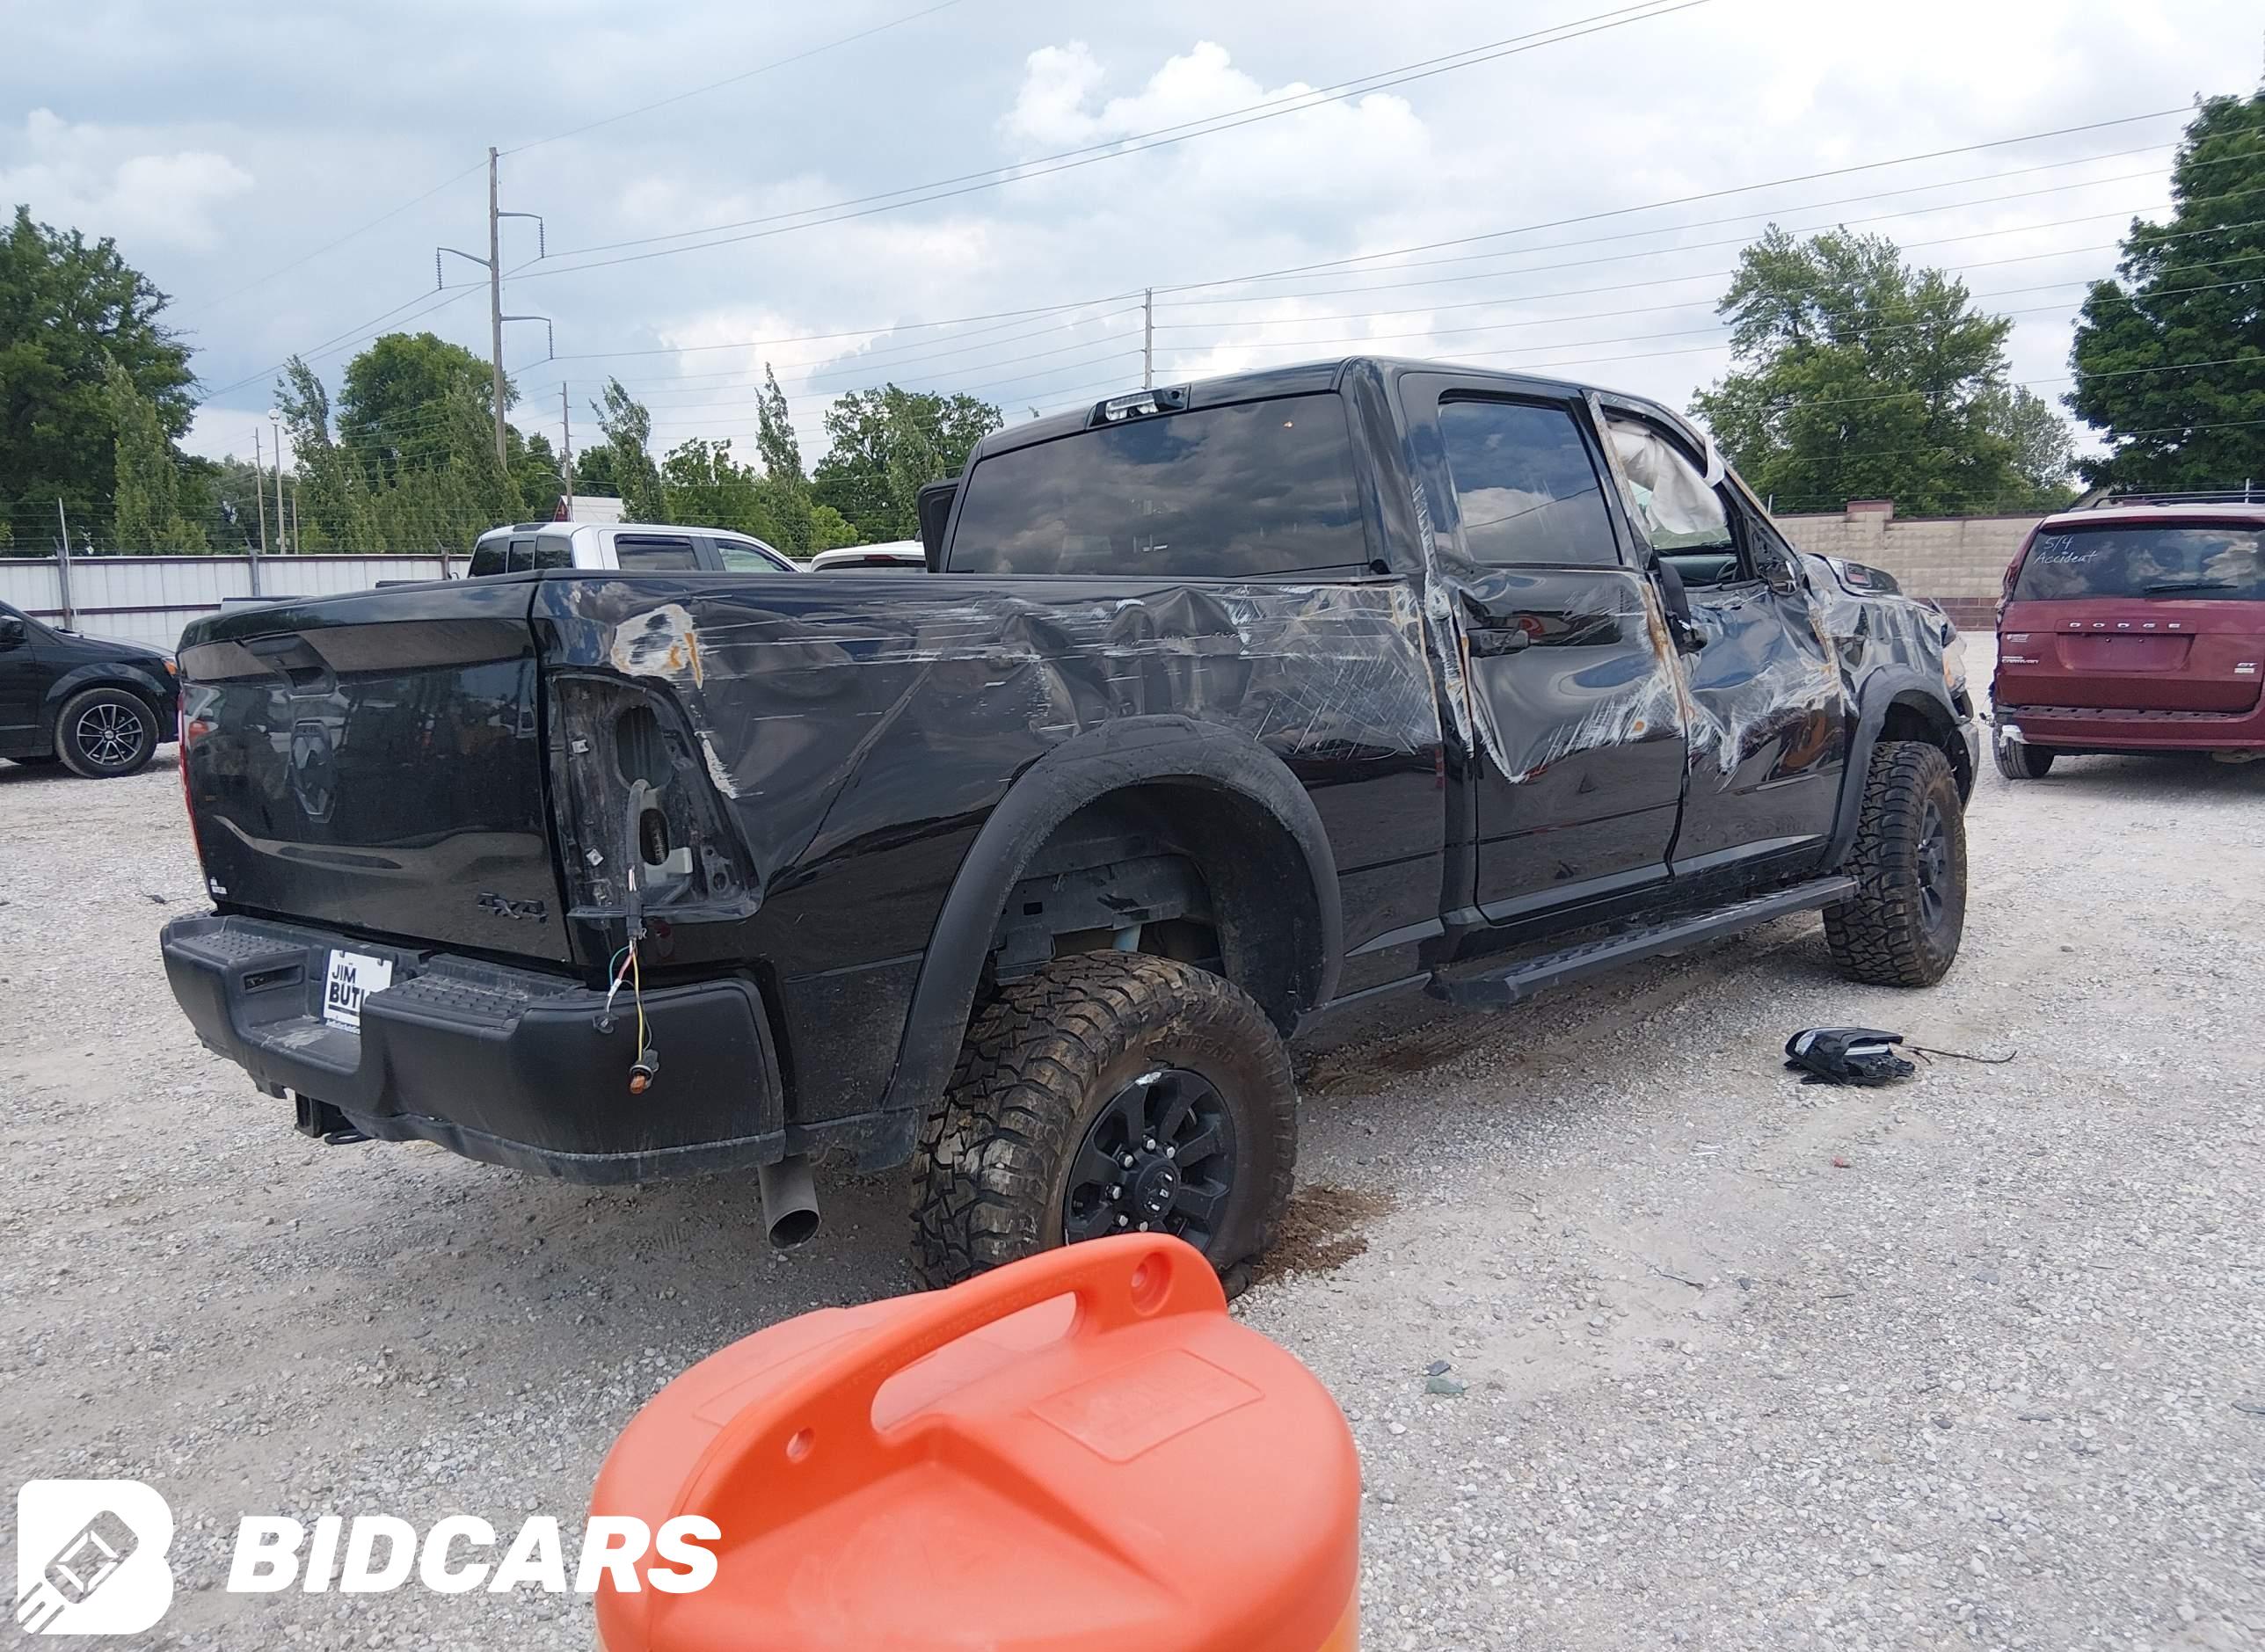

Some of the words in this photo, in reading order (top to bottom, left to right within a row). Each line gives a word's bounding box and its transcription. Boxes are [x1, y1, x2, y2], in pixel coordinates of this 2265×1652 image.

[2043, 535, 2074, 551] 5/4
[2033, 550, 2098, 564] Accident
[331, 964, 357, 984] JIM
